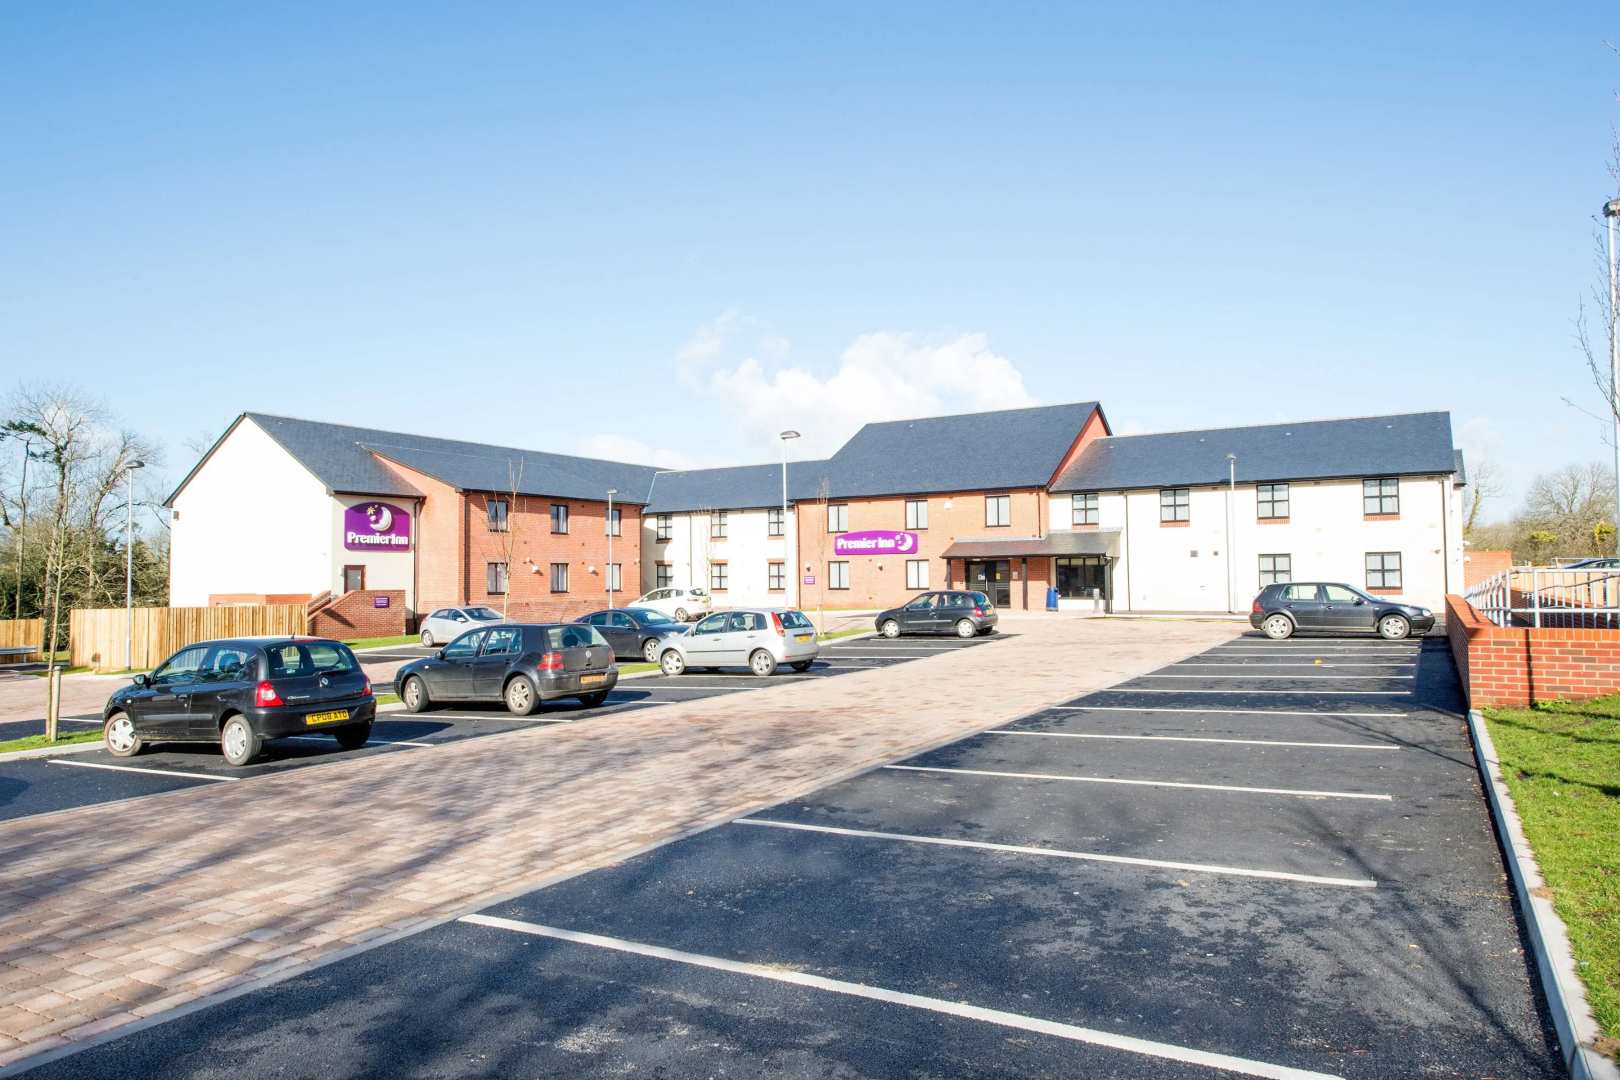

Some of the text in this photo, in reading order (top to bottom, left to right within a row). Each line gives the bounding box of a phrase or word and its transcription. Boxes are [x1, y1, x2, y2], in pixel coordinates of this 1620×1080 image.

[347, 531, 409, 545] Premier Inn
[837, 537, 895, 549] Premier Inn
[311, 713, 332, 722] CP08
